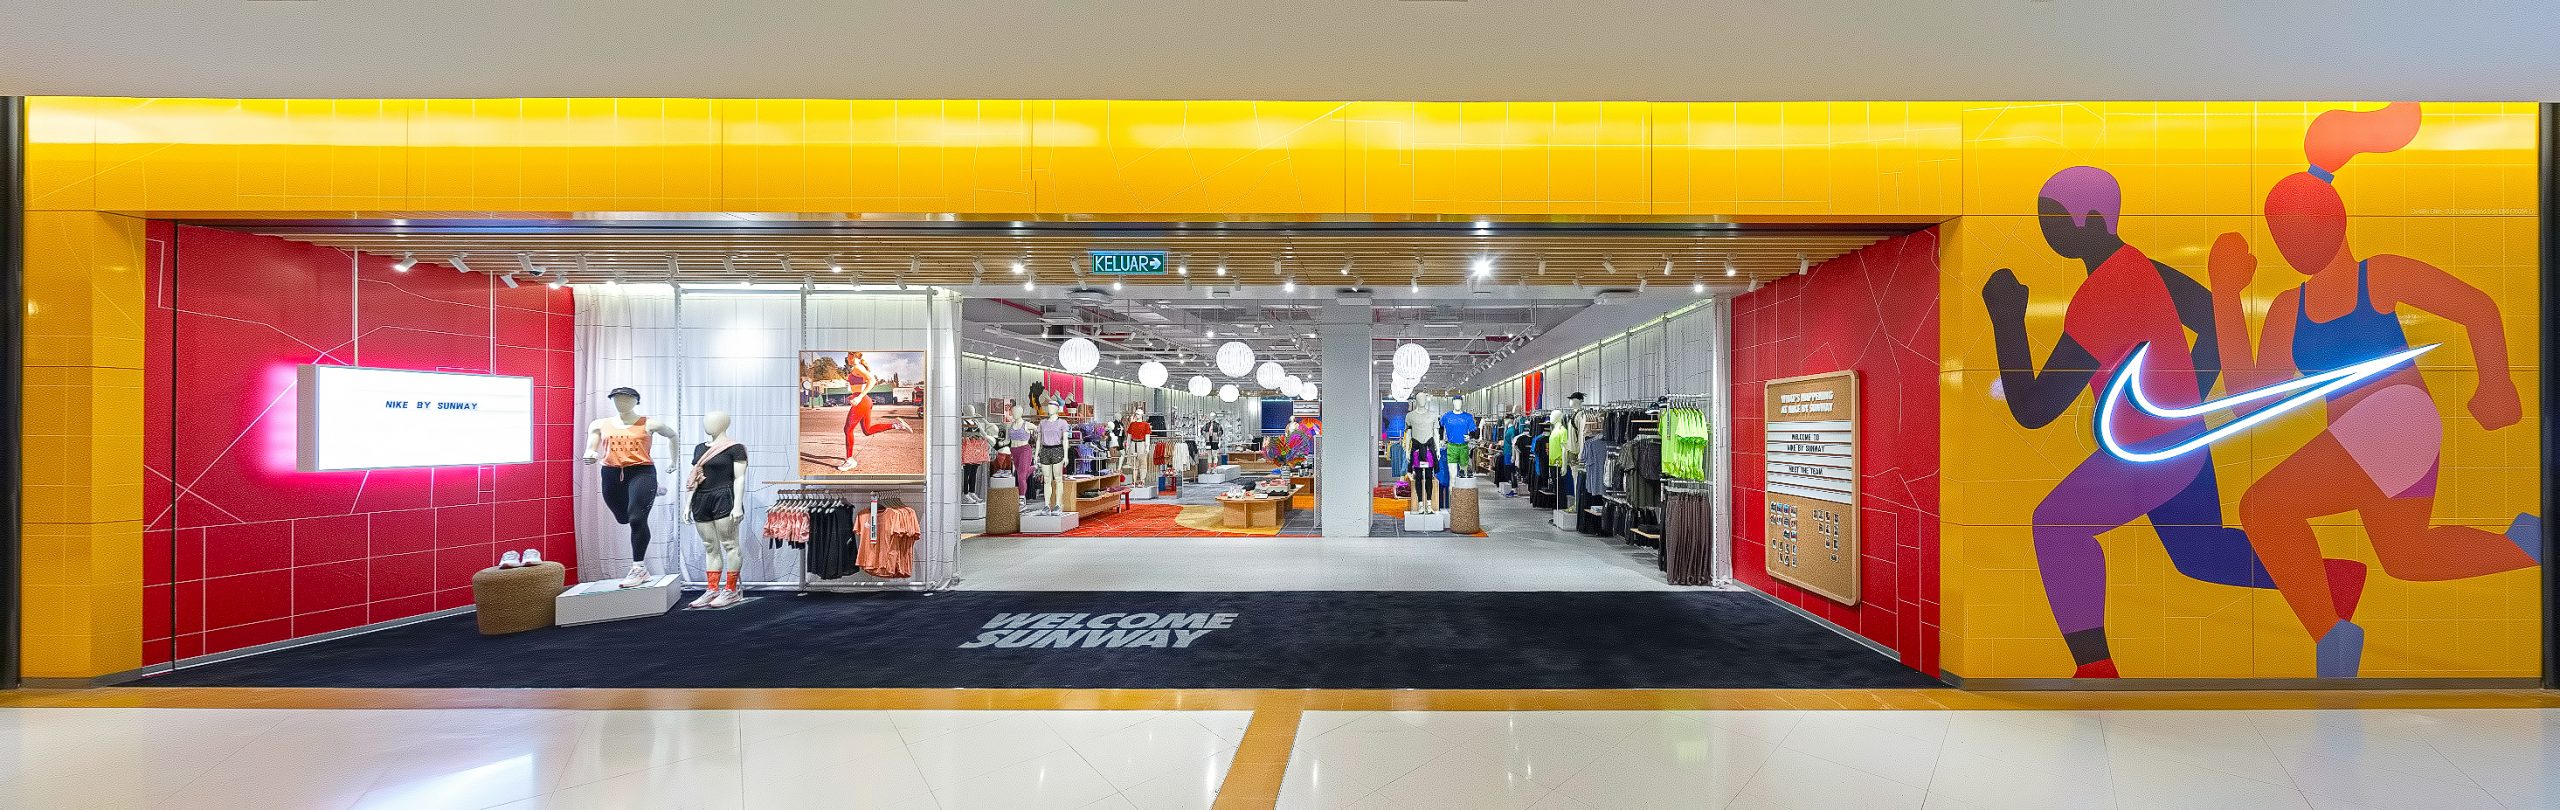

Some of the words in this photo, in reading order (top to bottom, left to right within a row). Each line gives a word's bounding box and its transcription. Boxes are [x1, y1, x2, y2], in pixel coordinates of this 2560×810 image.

[1095, 255, 1149, 272] KELUAR
[385, 400, 408, 409] NIKE
[416, 401, 431, 409] BY
[437, 402, 478, 410] SUNWAY
[1813, 433, 1820, 441] TO
[981, 612, 1239, 629] WELCOME
[957, 629, 1213, 649] SUNWAY
